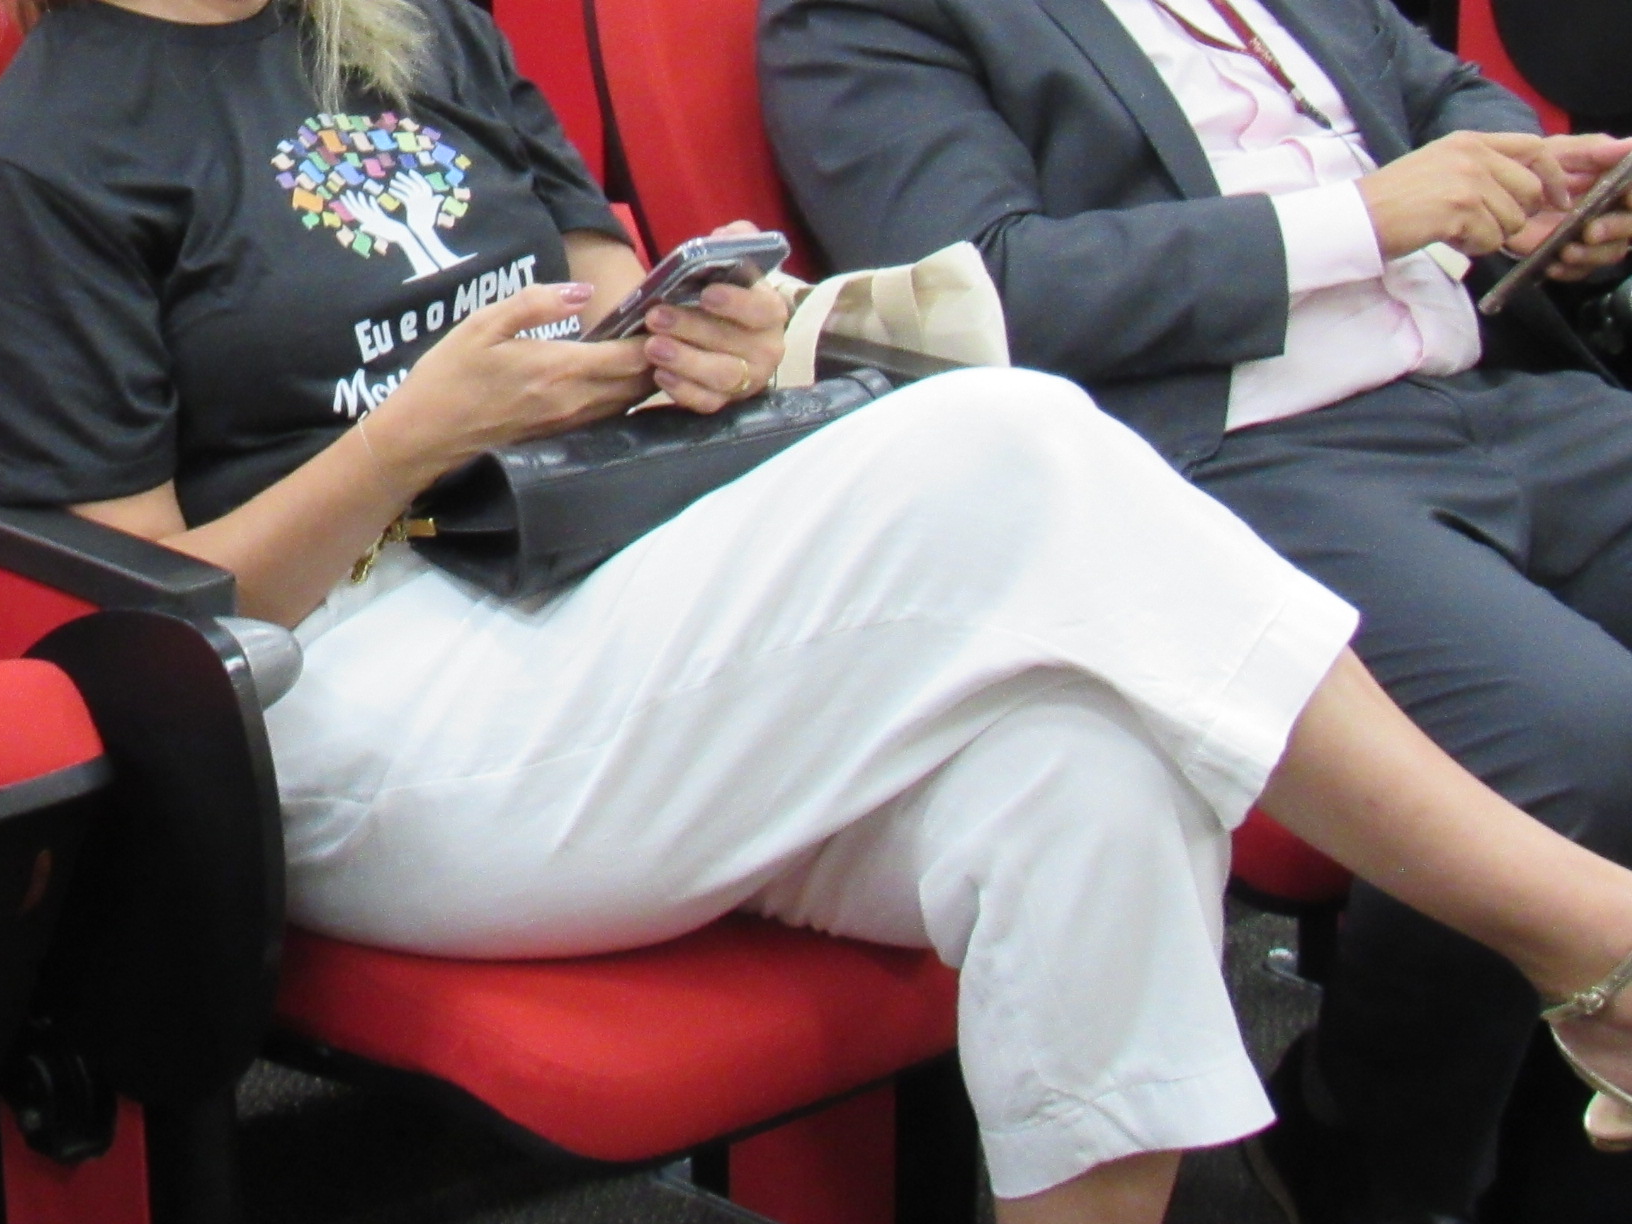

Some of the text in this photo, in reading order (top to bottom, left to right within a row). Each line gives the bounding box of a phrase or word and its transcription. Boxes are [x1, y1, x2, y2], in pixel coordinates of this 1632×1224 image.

[354, 254, 537, 364] Eu e o MPMT
